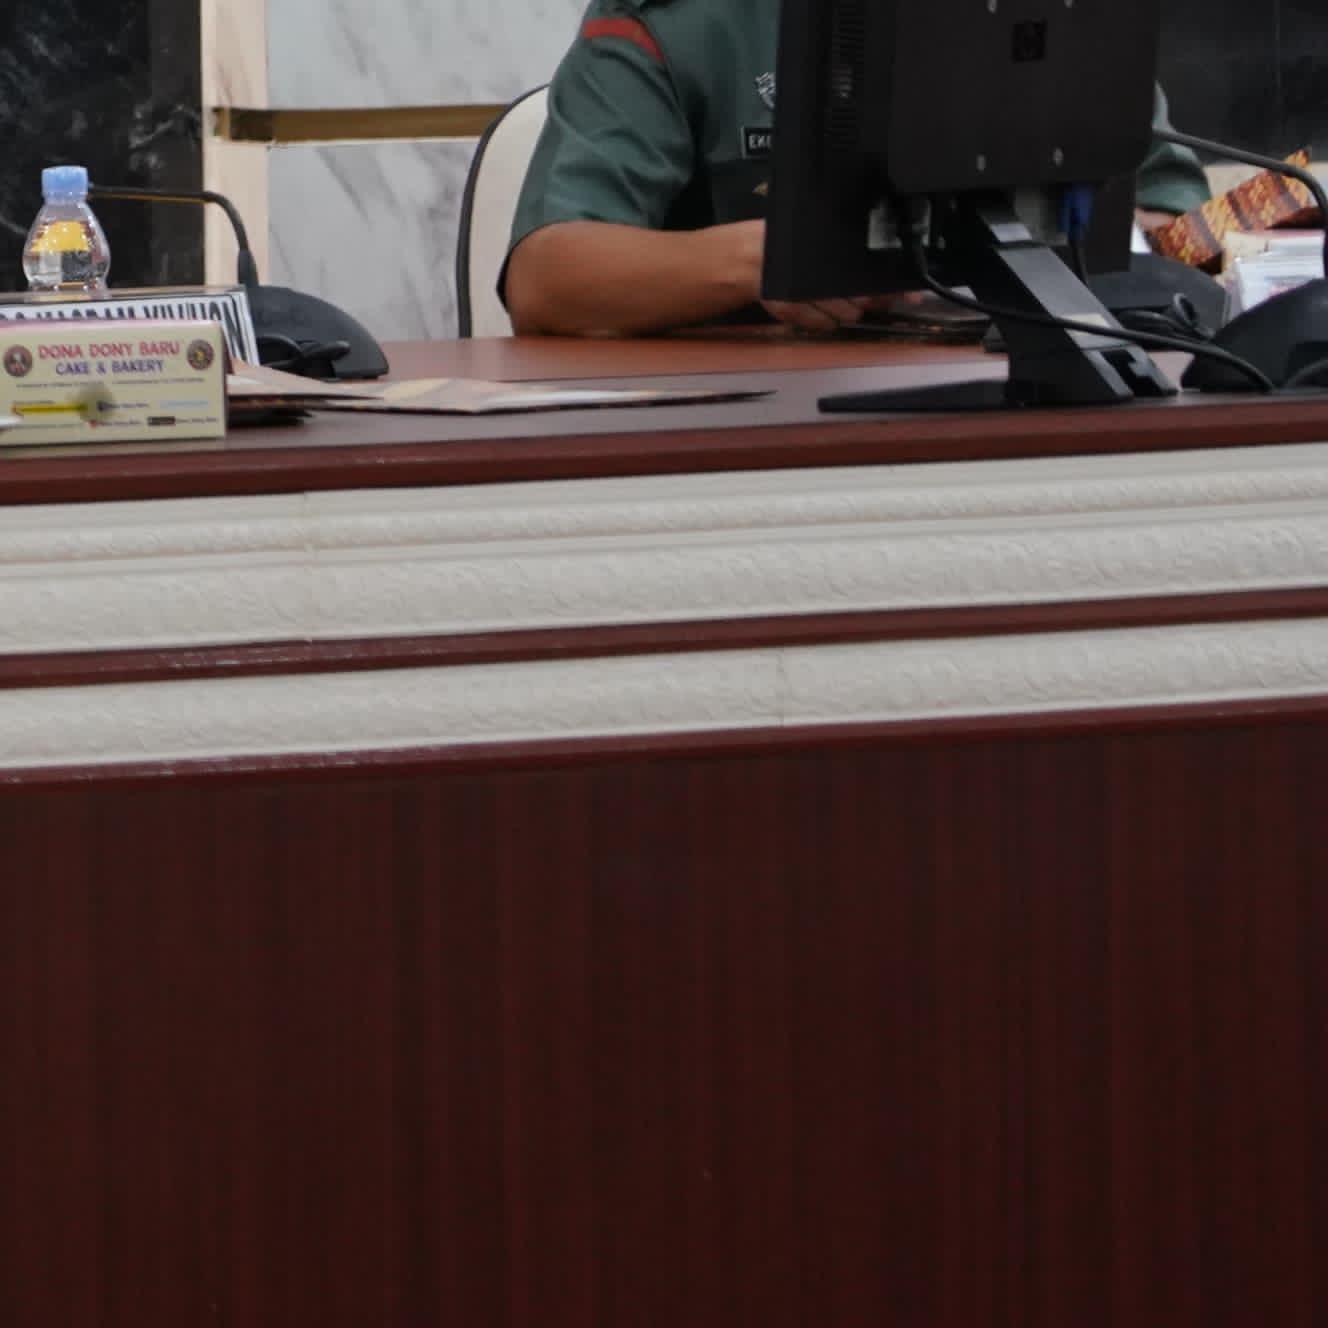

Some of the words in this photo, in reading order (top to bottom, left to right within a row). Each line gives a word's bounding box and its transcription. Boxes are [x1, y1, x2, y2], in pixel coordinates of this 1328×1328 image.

[37, 344, 84, 360] DONA
[88, 343, 133, 358] DONY
[139, 341, 180, 356] BARU
[55, 361, 89, 375] CAKE
[111, 359, 164, 373] BAKERY
